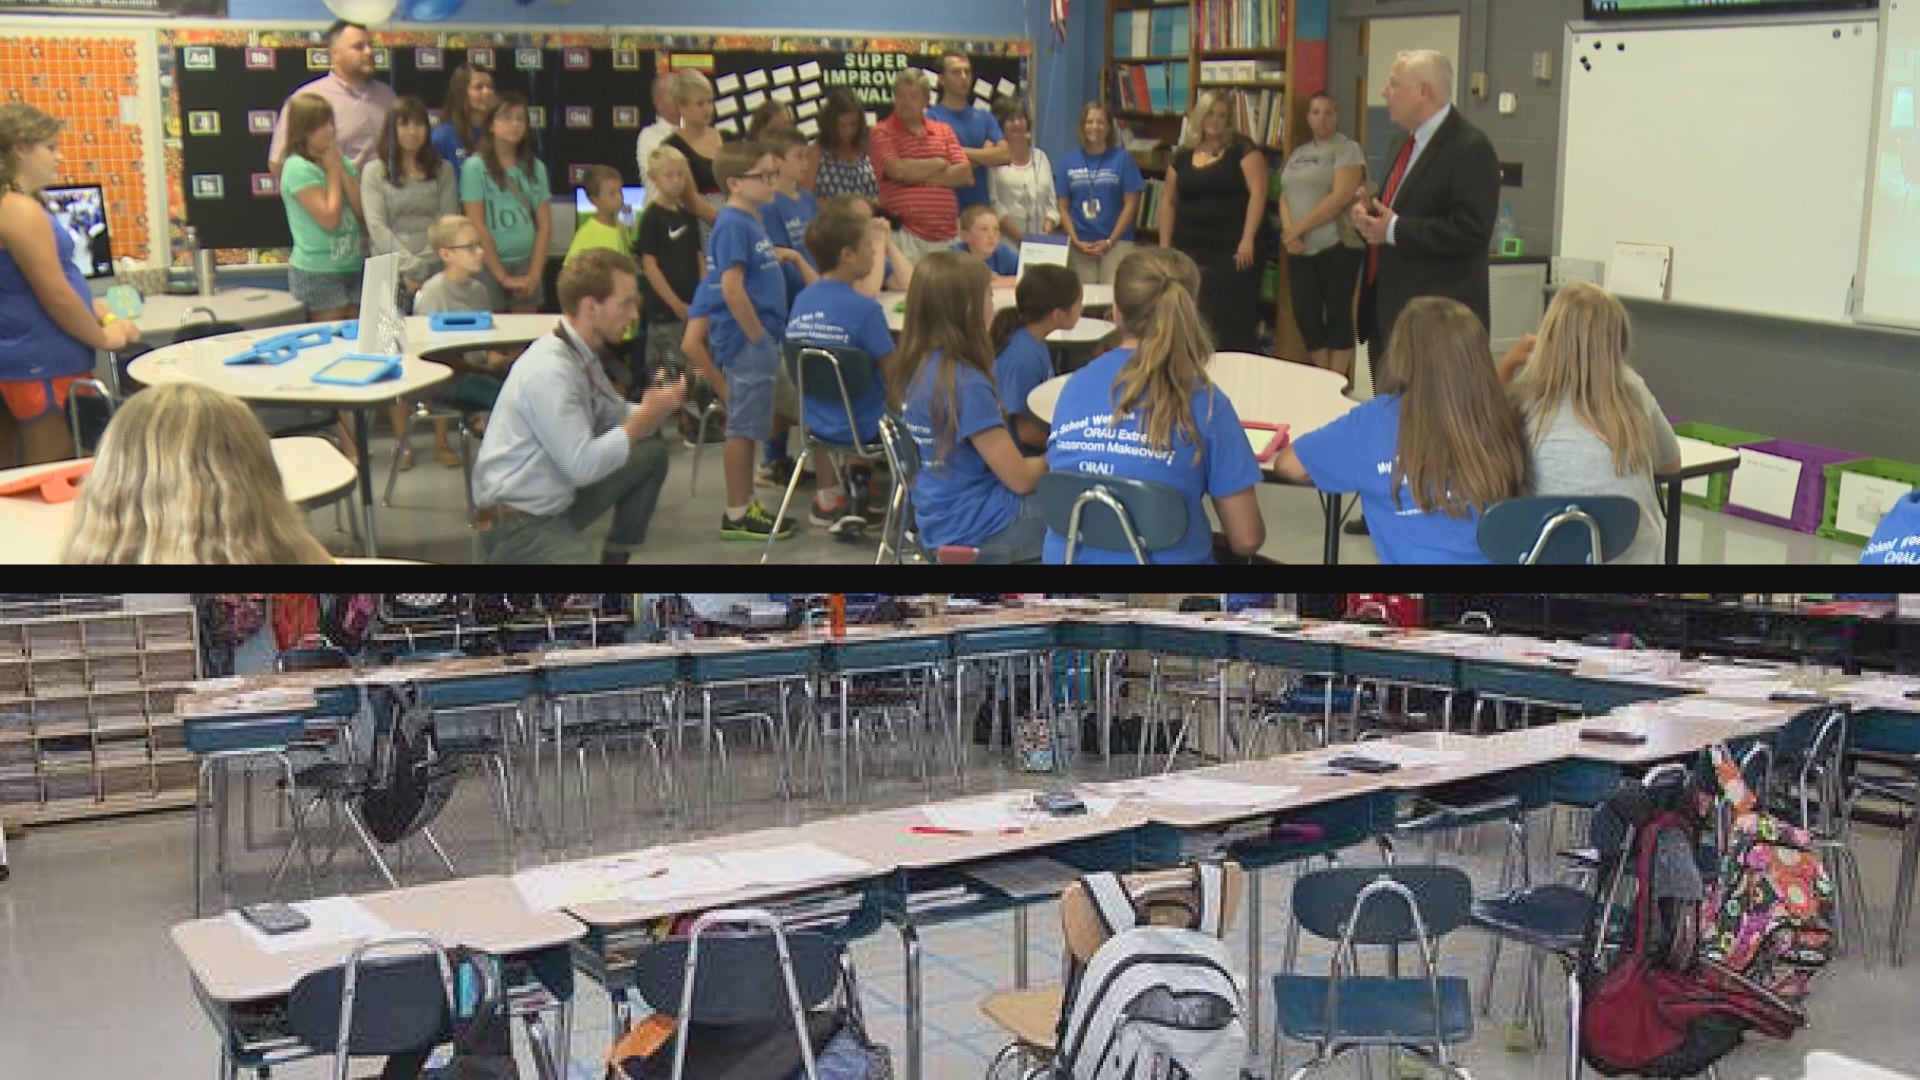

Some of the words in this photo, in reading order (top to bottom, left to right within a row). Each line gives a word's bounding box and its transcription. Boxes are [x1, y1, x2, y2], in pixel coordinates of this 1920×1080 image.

[190, 52, 209, 64] Aa
[251, 52, 268, 64] Bb
[844, 53, 908, 68] SUPER
[823, 69, 897, 86] IMPROV
[1083, 427, 1117, 439] ORAU
[1118, 429, 1149, 442] Extre
[1079, 461, 1114, 475] ORAU
